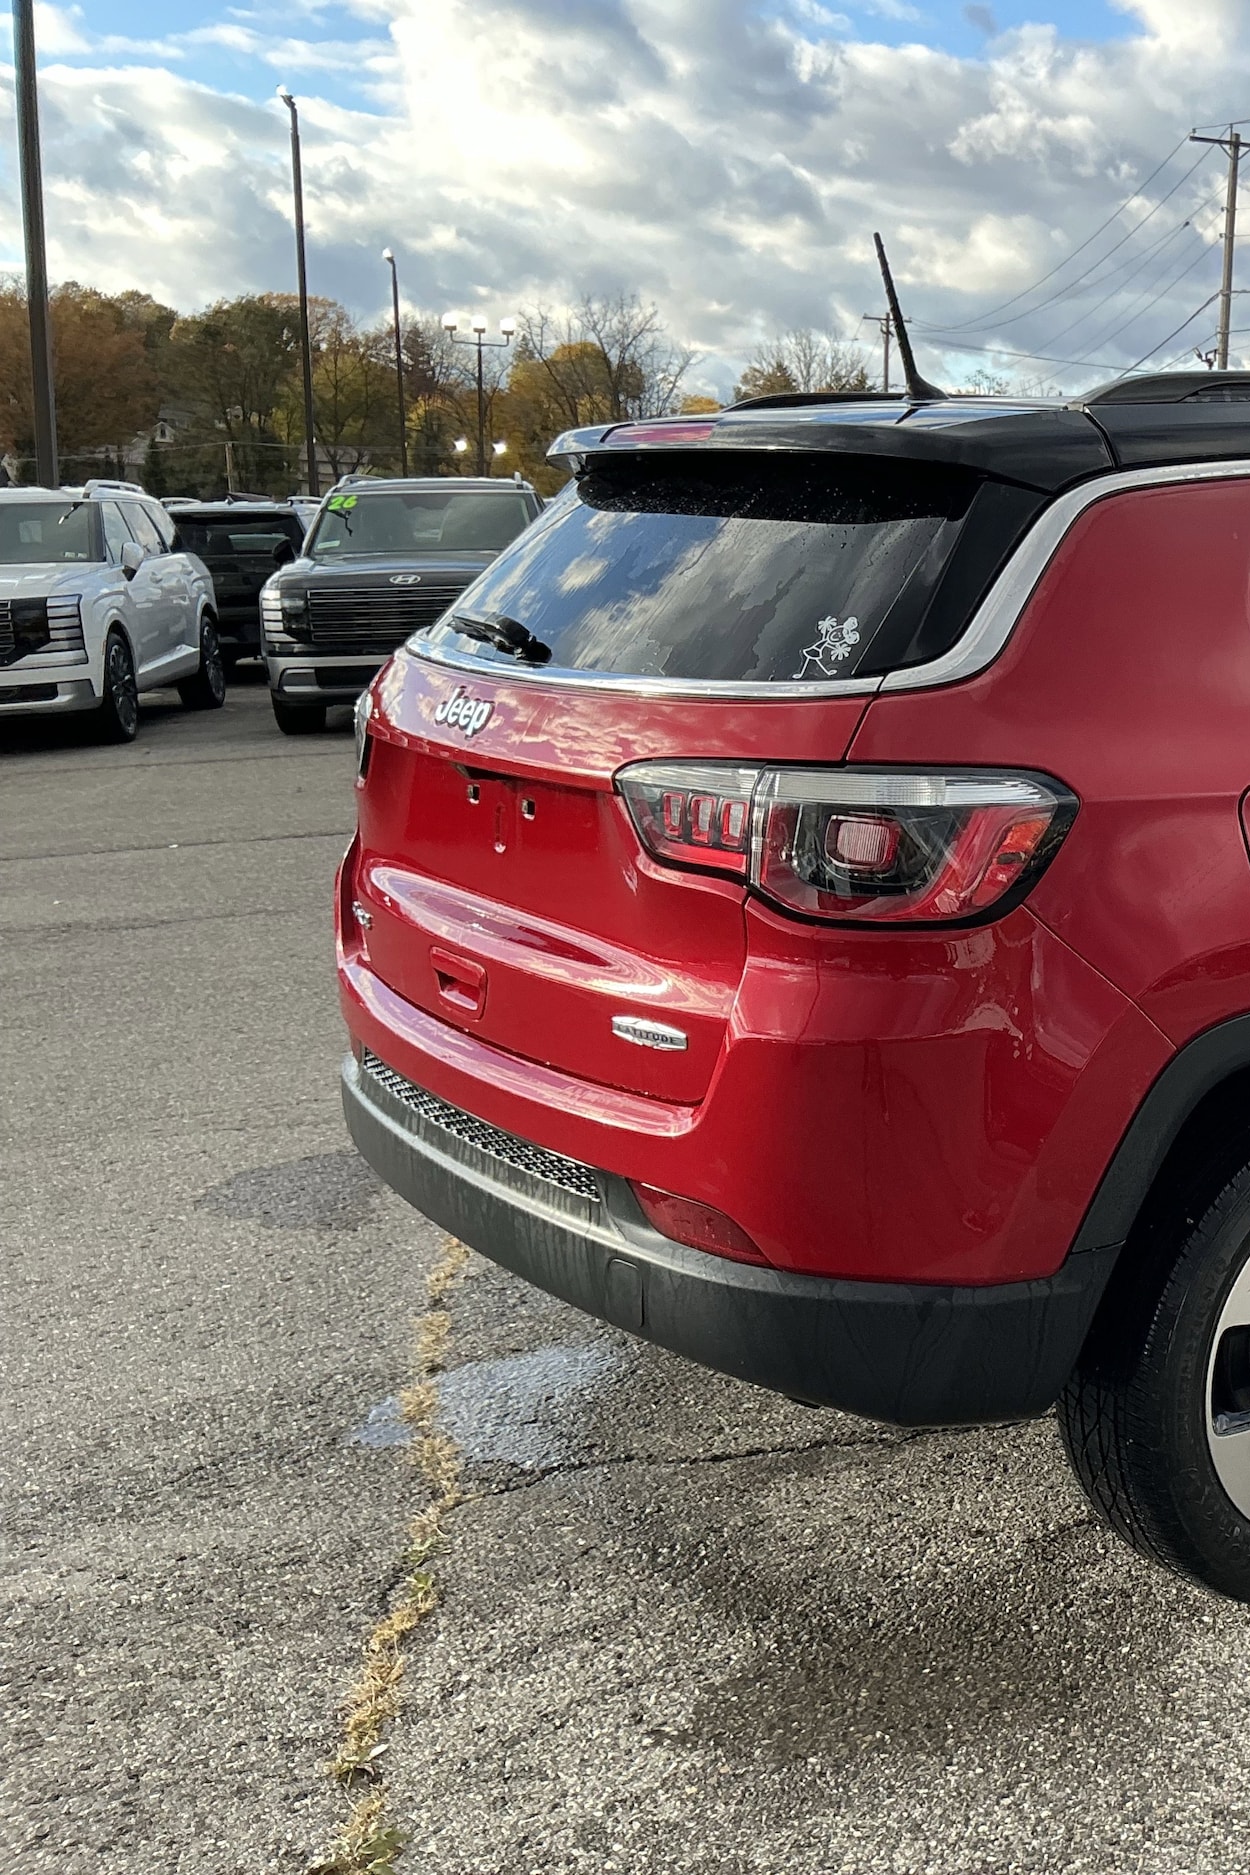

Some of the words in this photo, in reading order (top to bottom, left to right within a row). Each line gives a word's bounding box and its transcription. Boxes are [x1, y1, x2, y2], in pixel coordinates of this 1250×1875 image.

[327, 495, 358, 511] 26
[434, 686, 495, 740] Jeep
[616, 1023, 679, 1044] LATITUDE
